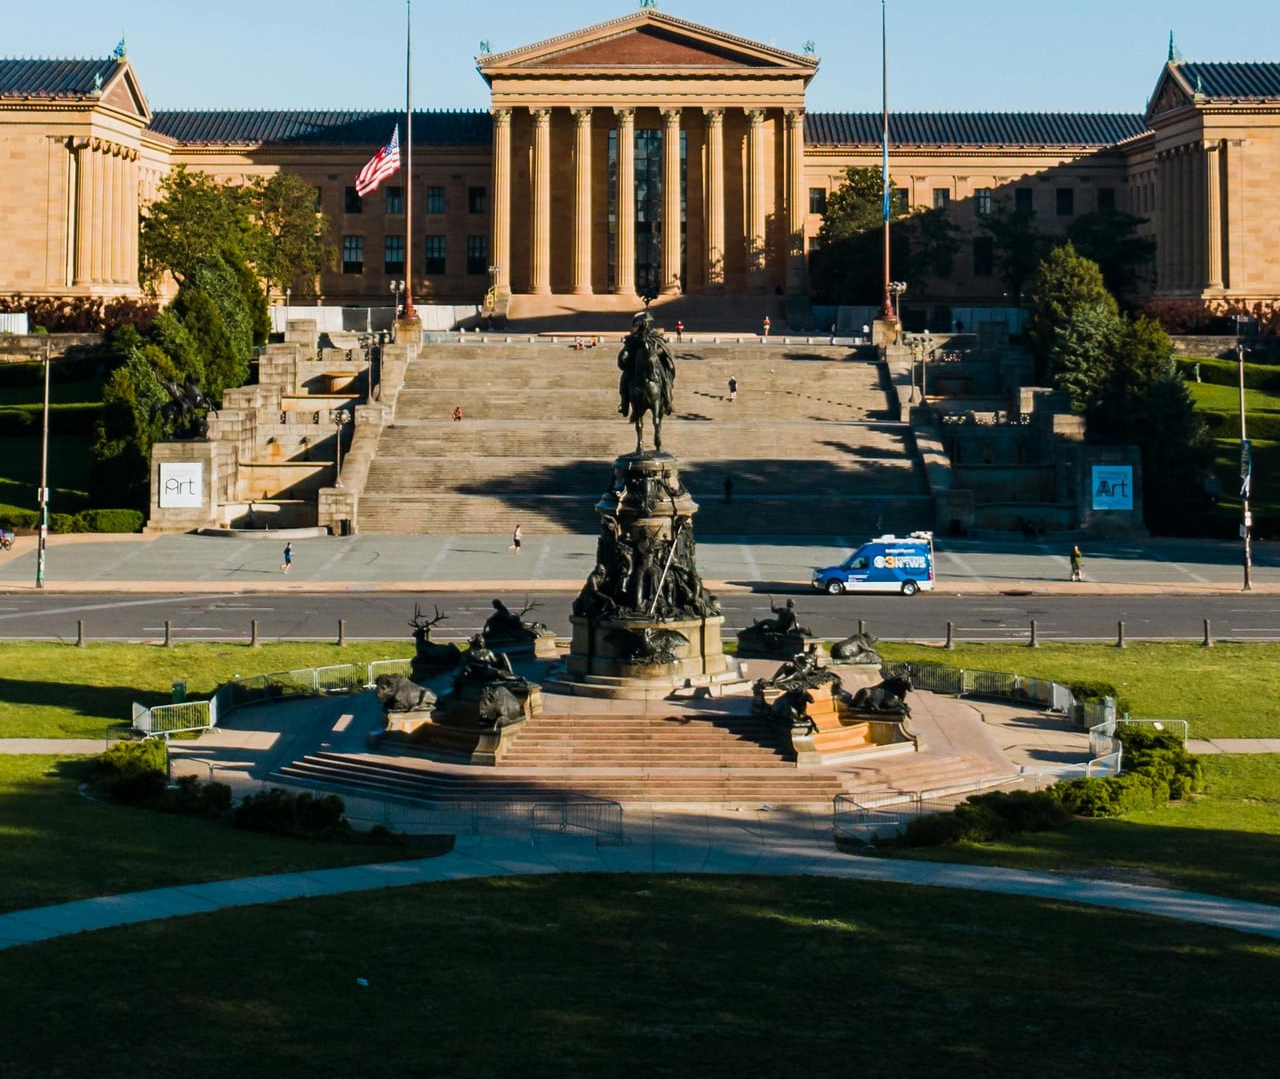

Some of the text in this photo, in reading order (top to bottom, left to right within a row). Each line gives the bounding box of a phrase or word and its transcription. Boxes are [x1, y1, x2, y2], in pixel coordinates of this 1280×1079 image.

[165, 477, 195, 496] Art
[1095, 480, 1128, 497] Art
[885, 556, 896, 569] 3
